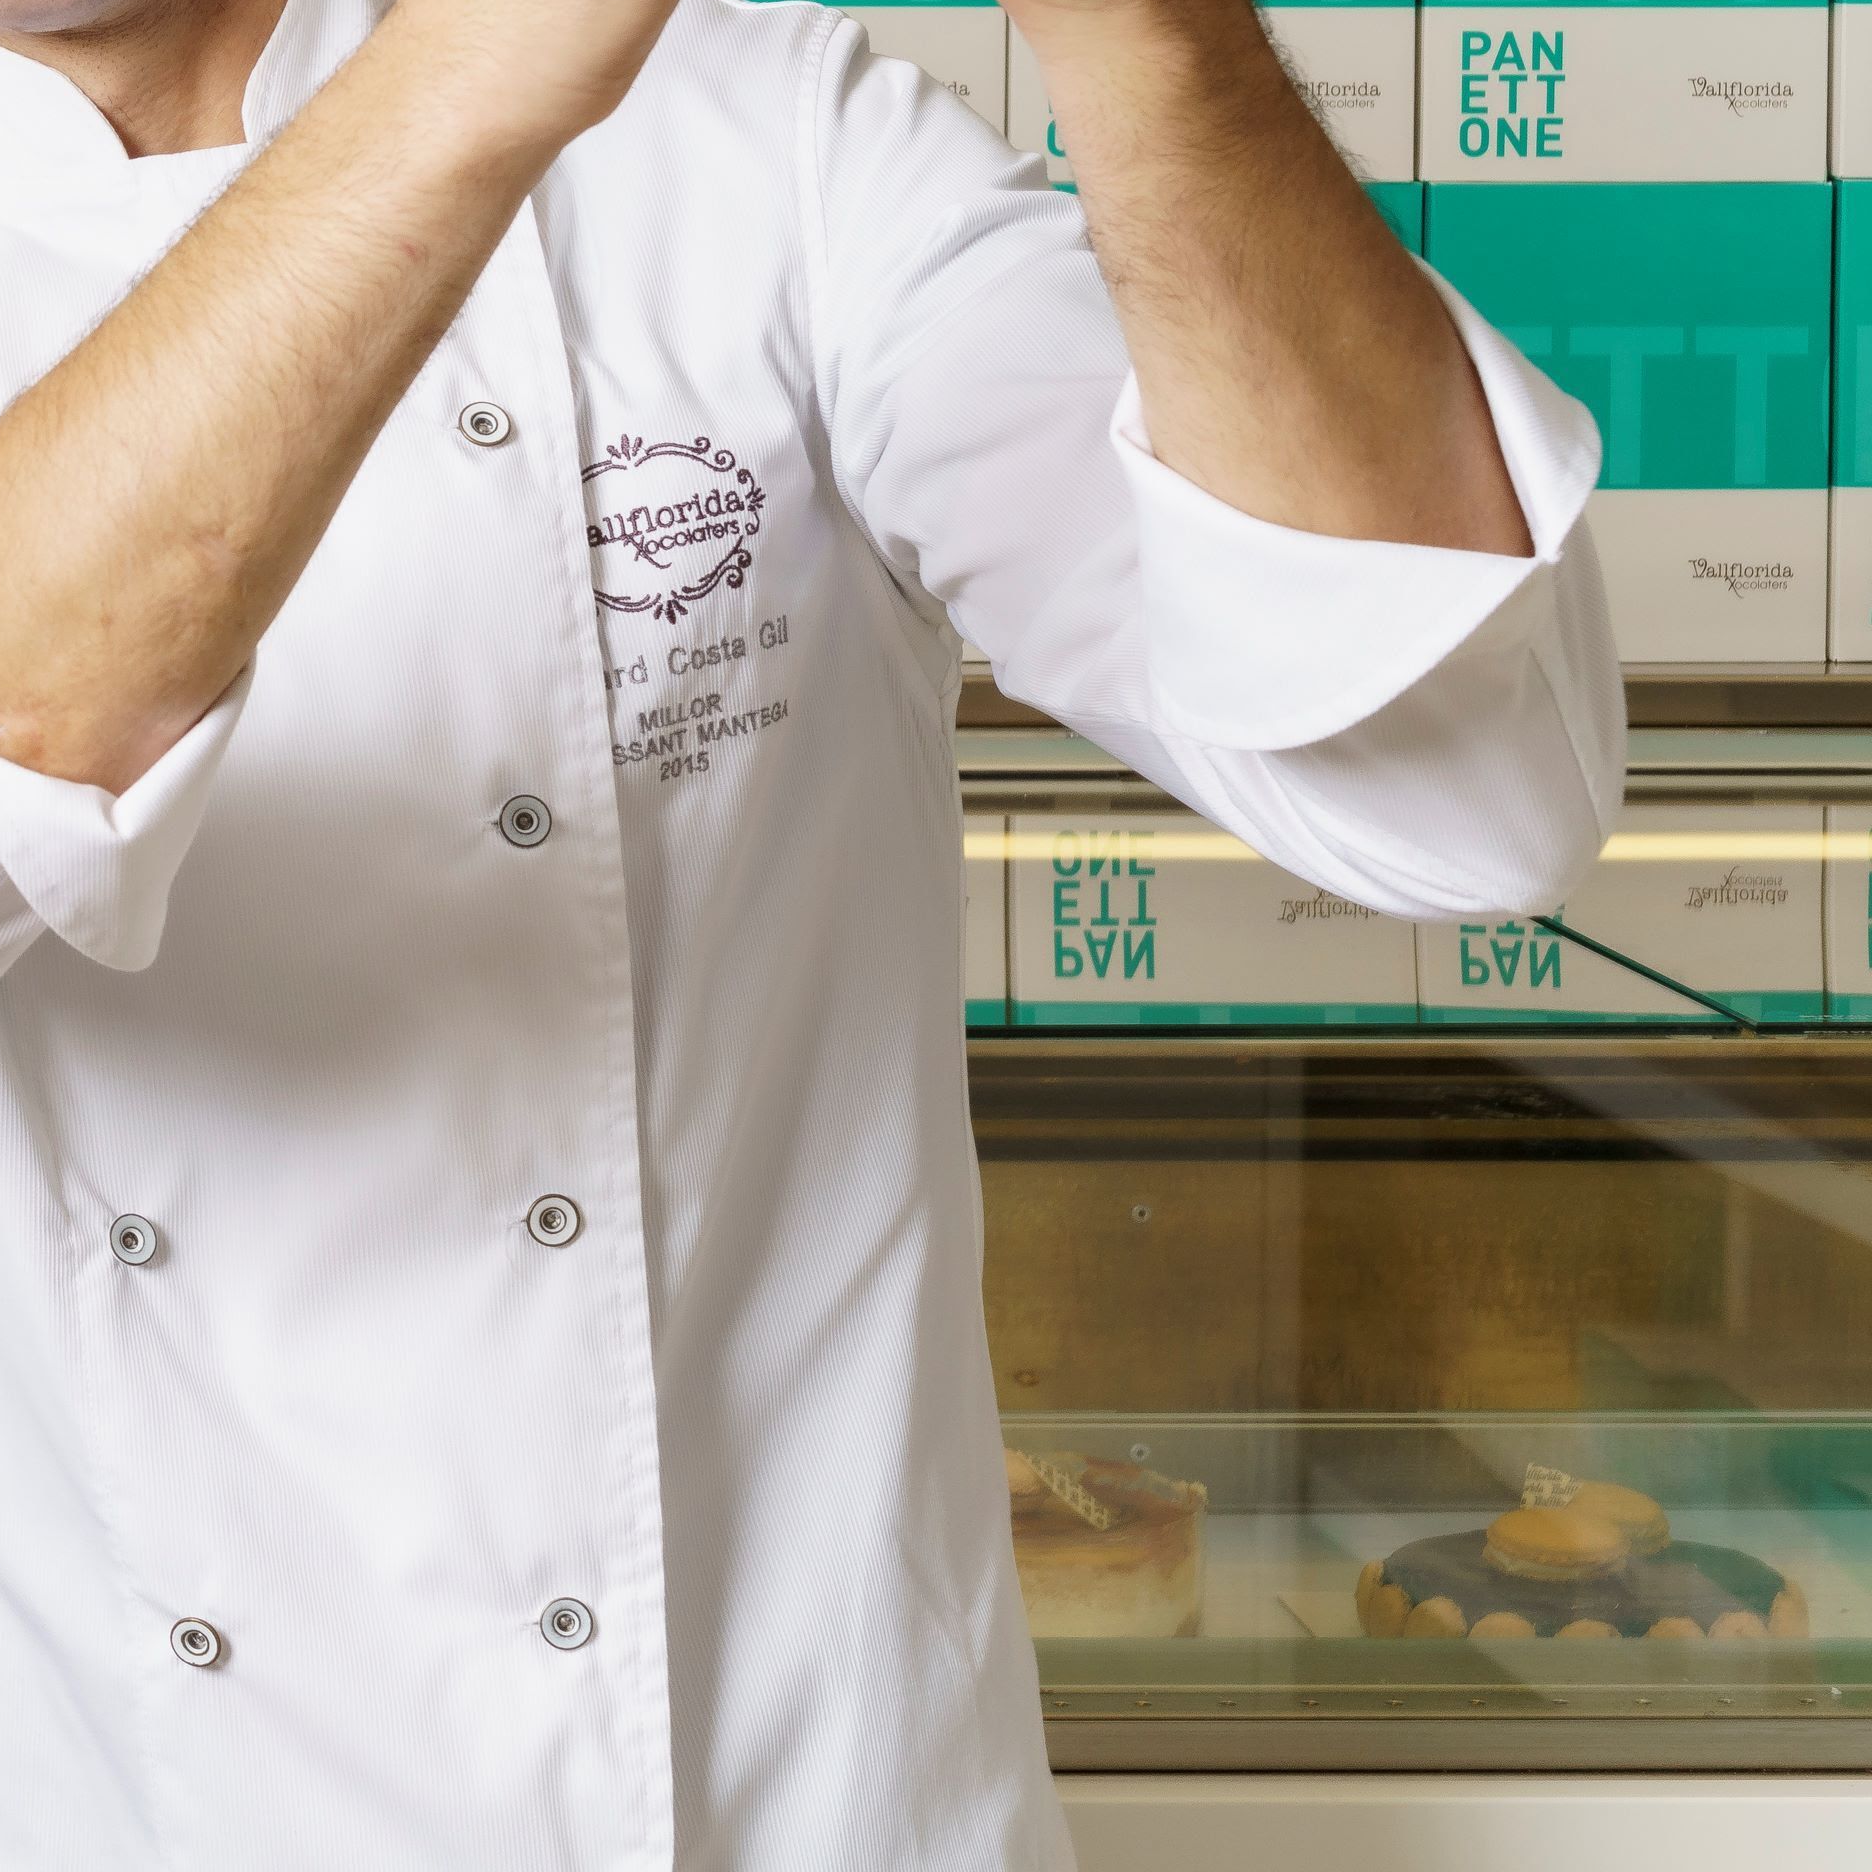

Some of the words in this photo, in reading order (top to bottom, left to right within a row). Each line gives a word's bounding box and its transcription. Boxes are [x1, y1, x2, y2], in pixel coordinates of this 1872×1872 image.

[1461, 31, 1563, 70] PAN
[1461, 74, 1565, 114] ETT
[1687, 77, 1793, 96] Vallflorida
[1725, 95, 1788, 117] Xocolaters
[1459, 118, 1563, 157] ONE
[1496, 327, 1808, 484] TT
[587, 489, 744, 547] allflorida
[1688, 558, 1793, 578] Vallflorida
[1724, 575, 1788, 599] Xocolaters
[667, 636, 746, 675] Costa
[759, 615, 789, 650] Gil
[638, 694, 722, 733] MILLOR
[660, 752, 710, 781] 2015
